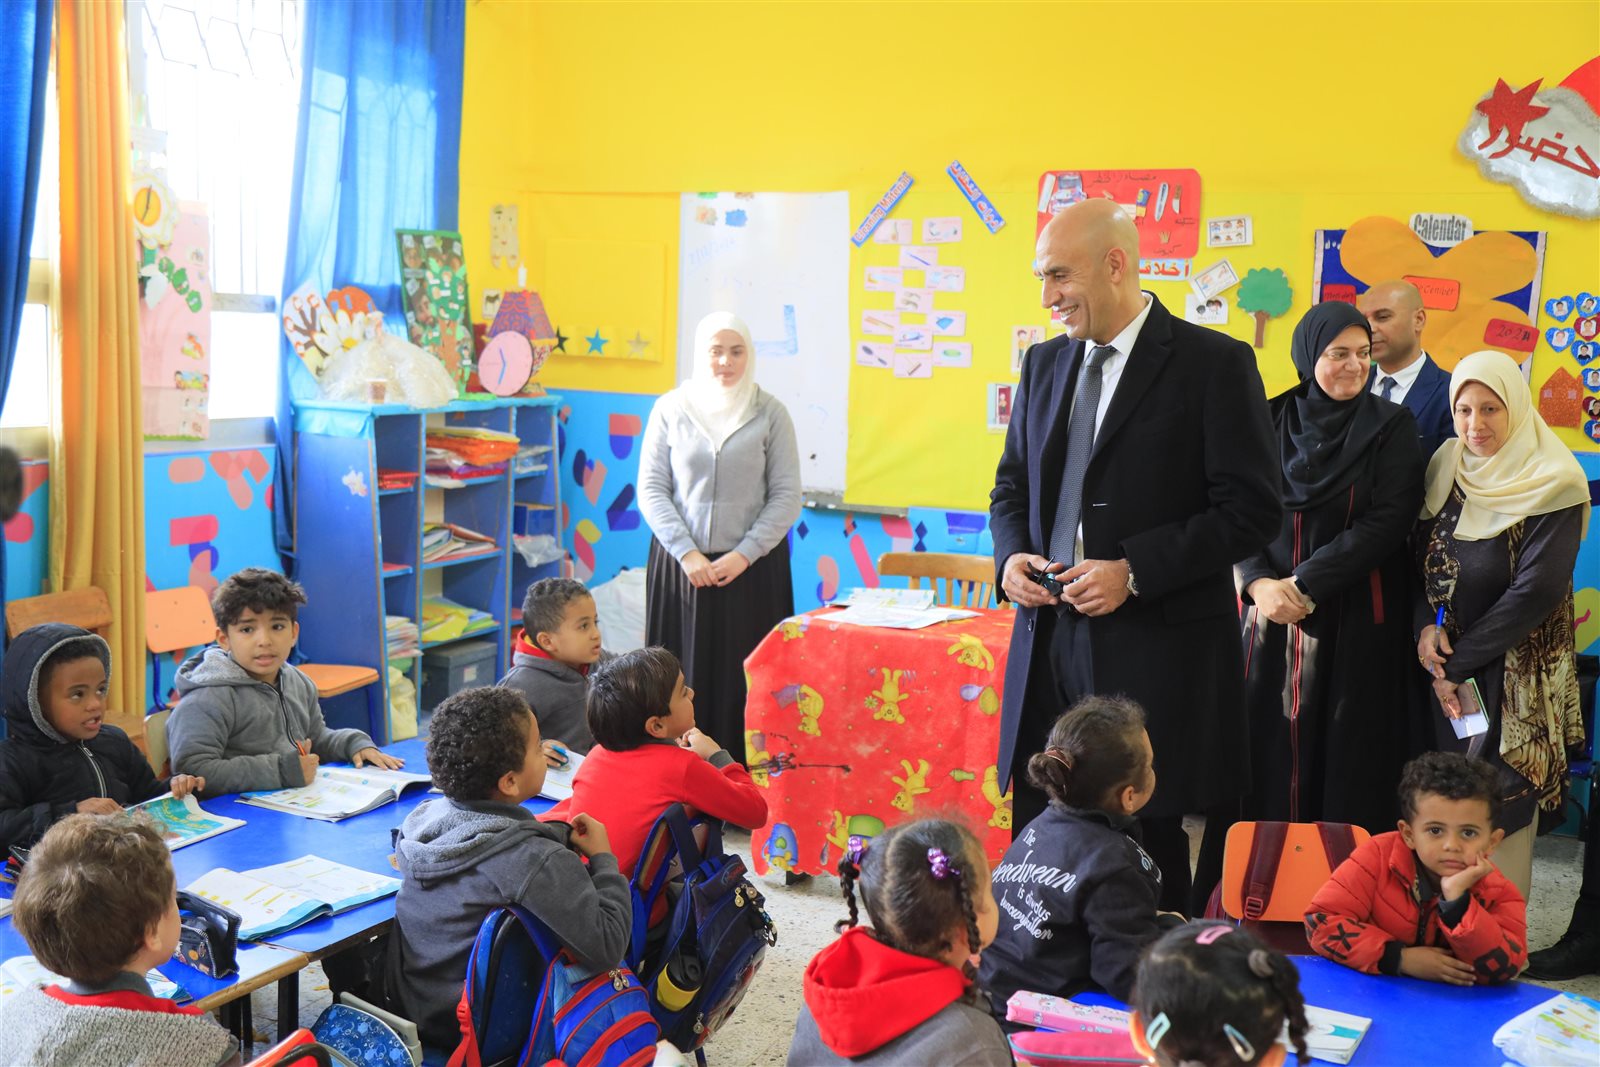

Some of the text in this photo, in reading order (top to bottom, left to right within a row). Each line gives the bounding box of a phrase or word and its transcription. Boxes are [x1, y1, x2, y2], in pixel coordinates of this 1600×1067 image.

[853, 206, 886, 242] Cleaning
[879, 174, 912, 209] Materials
[1413, 213, 1467, 242] Calendar
[1023, 828, 1037, 847] The
[1017, 883, 1026, 900] is
